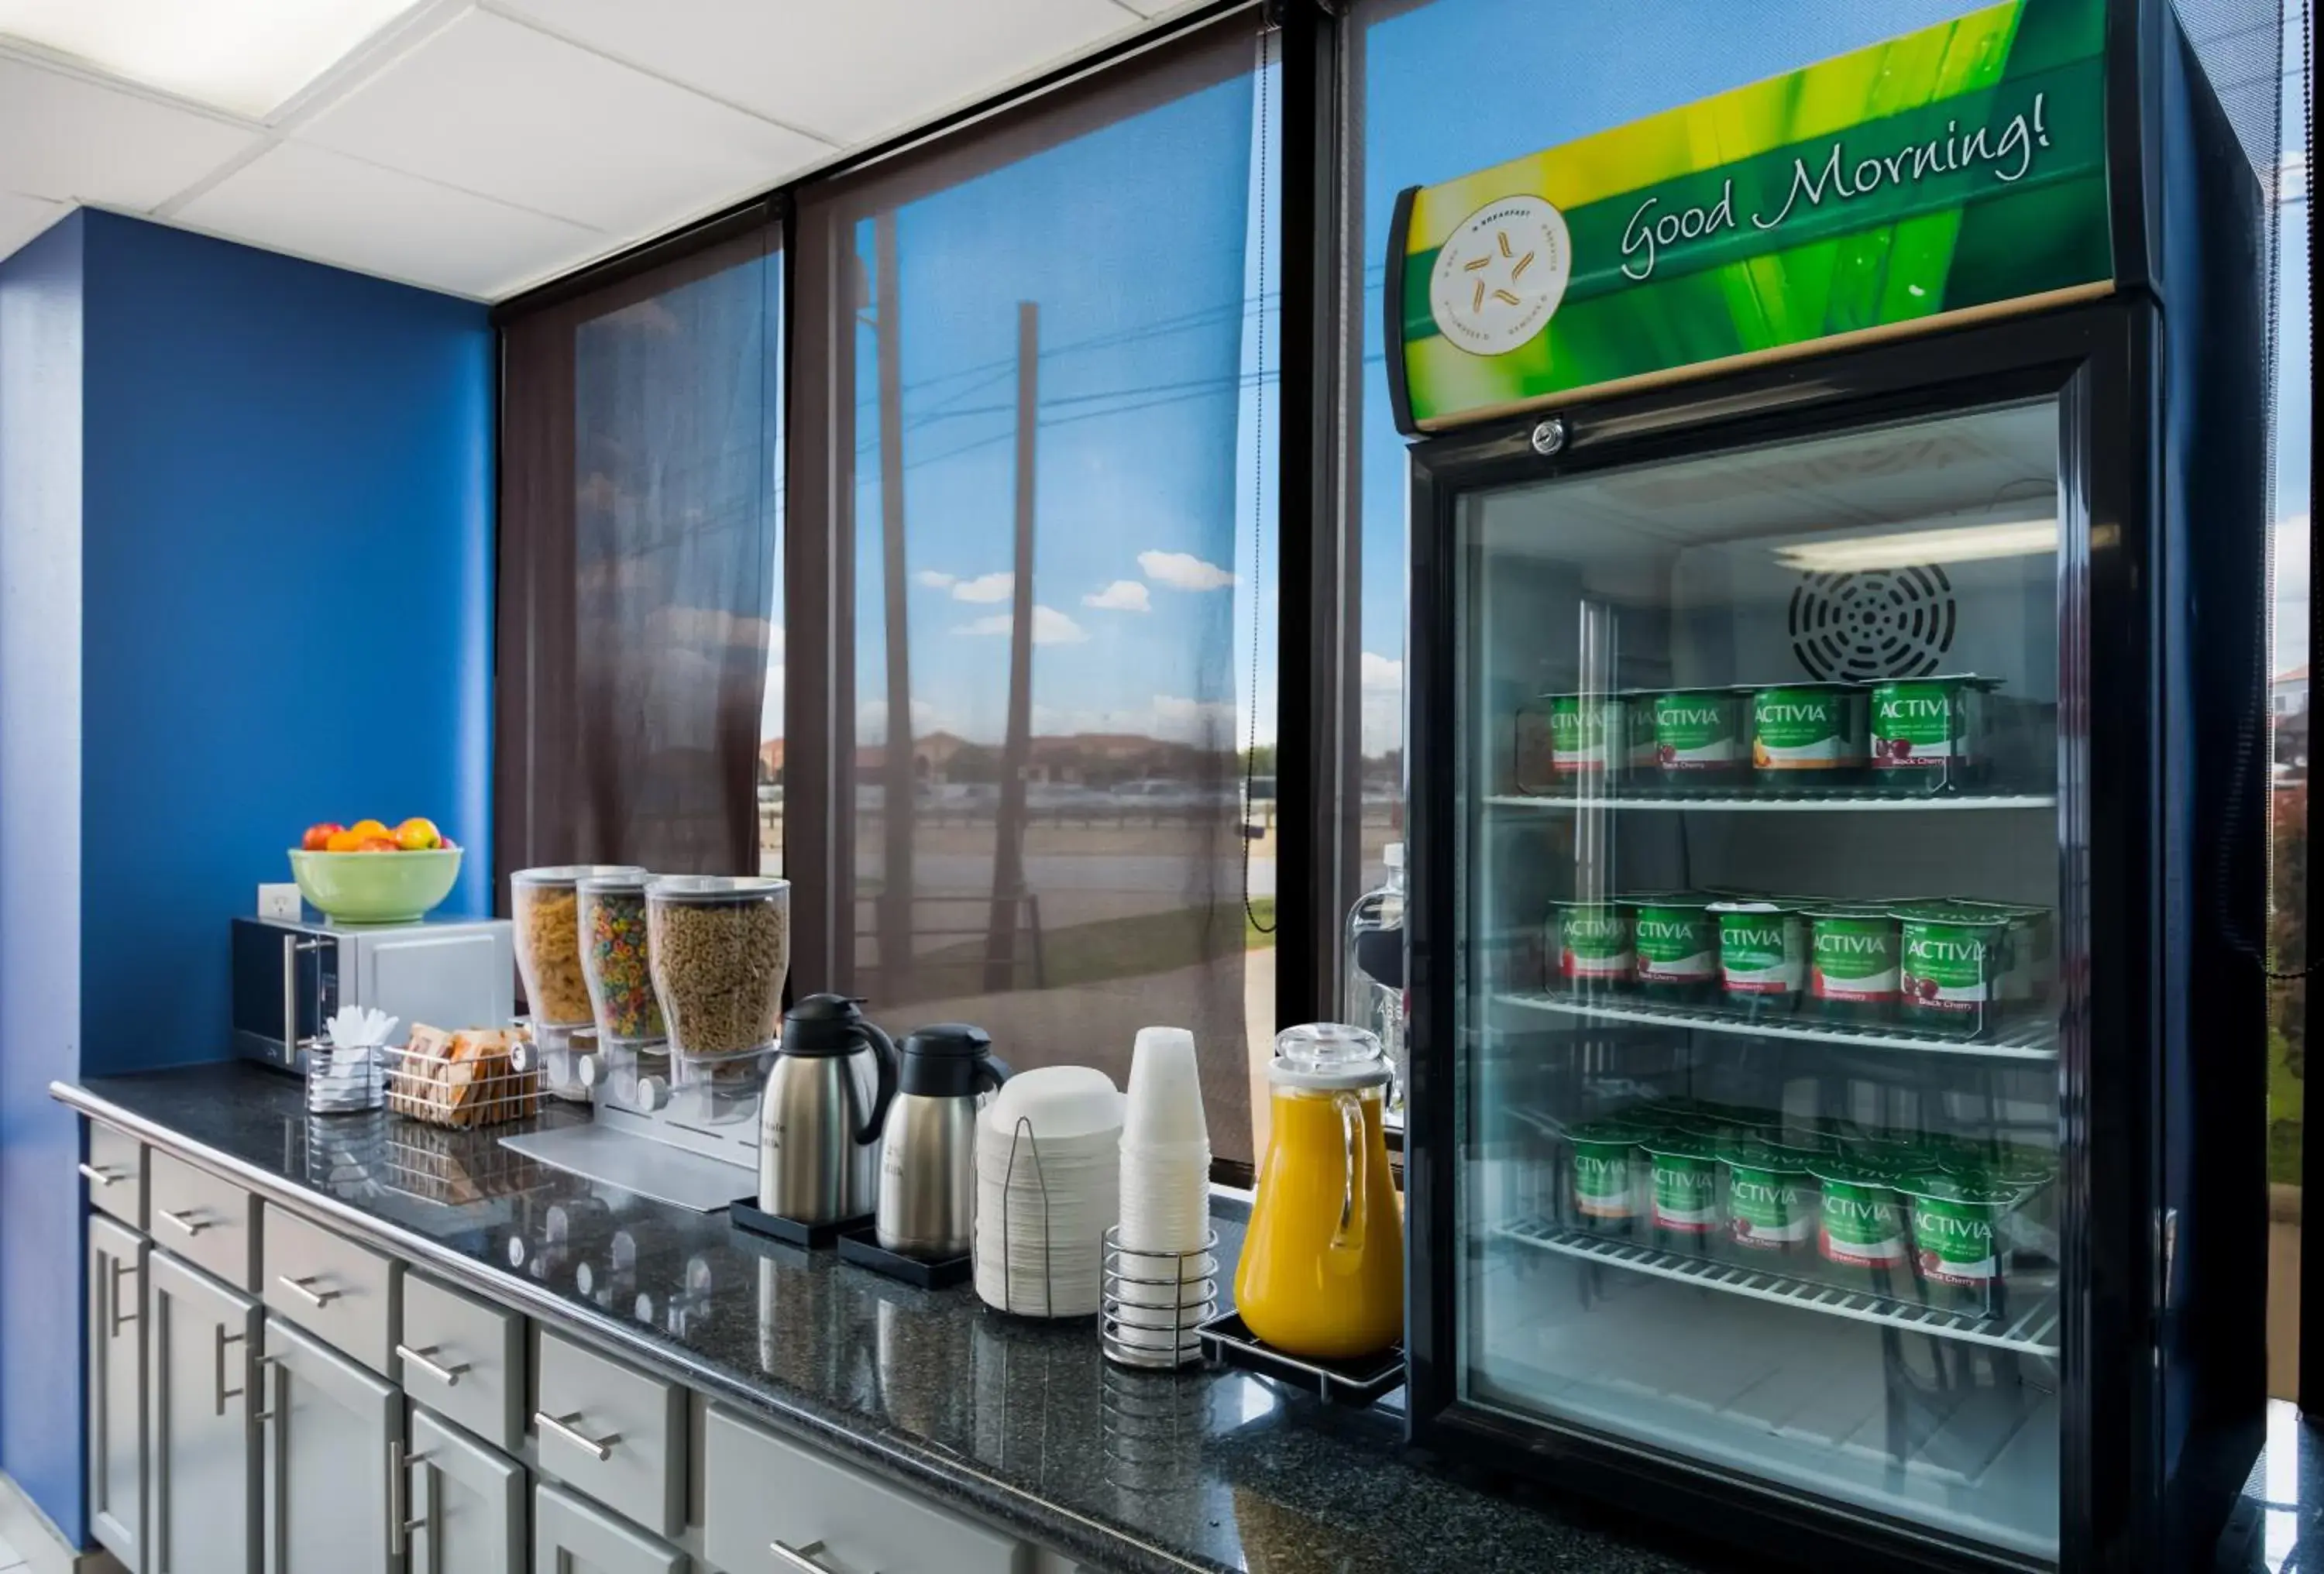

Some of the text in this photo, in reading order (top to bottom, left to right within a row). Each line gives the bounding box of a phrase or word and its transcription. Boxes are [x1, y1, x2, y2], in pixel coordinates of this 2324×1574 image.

[1620, 178, 1735, 280] Good
[1751, 93, 2051, 229] Morning!
[1755, 703, 1827, 723] ACTIVIA
[1635, 919, 1693, 940] CTIVIA
[1719, 929, 1782, 946] CTIVIA
[1813, 933, 1886, 954] ACTIVIA
[1915, 1210, 1993, 1240] ACTIVIA
